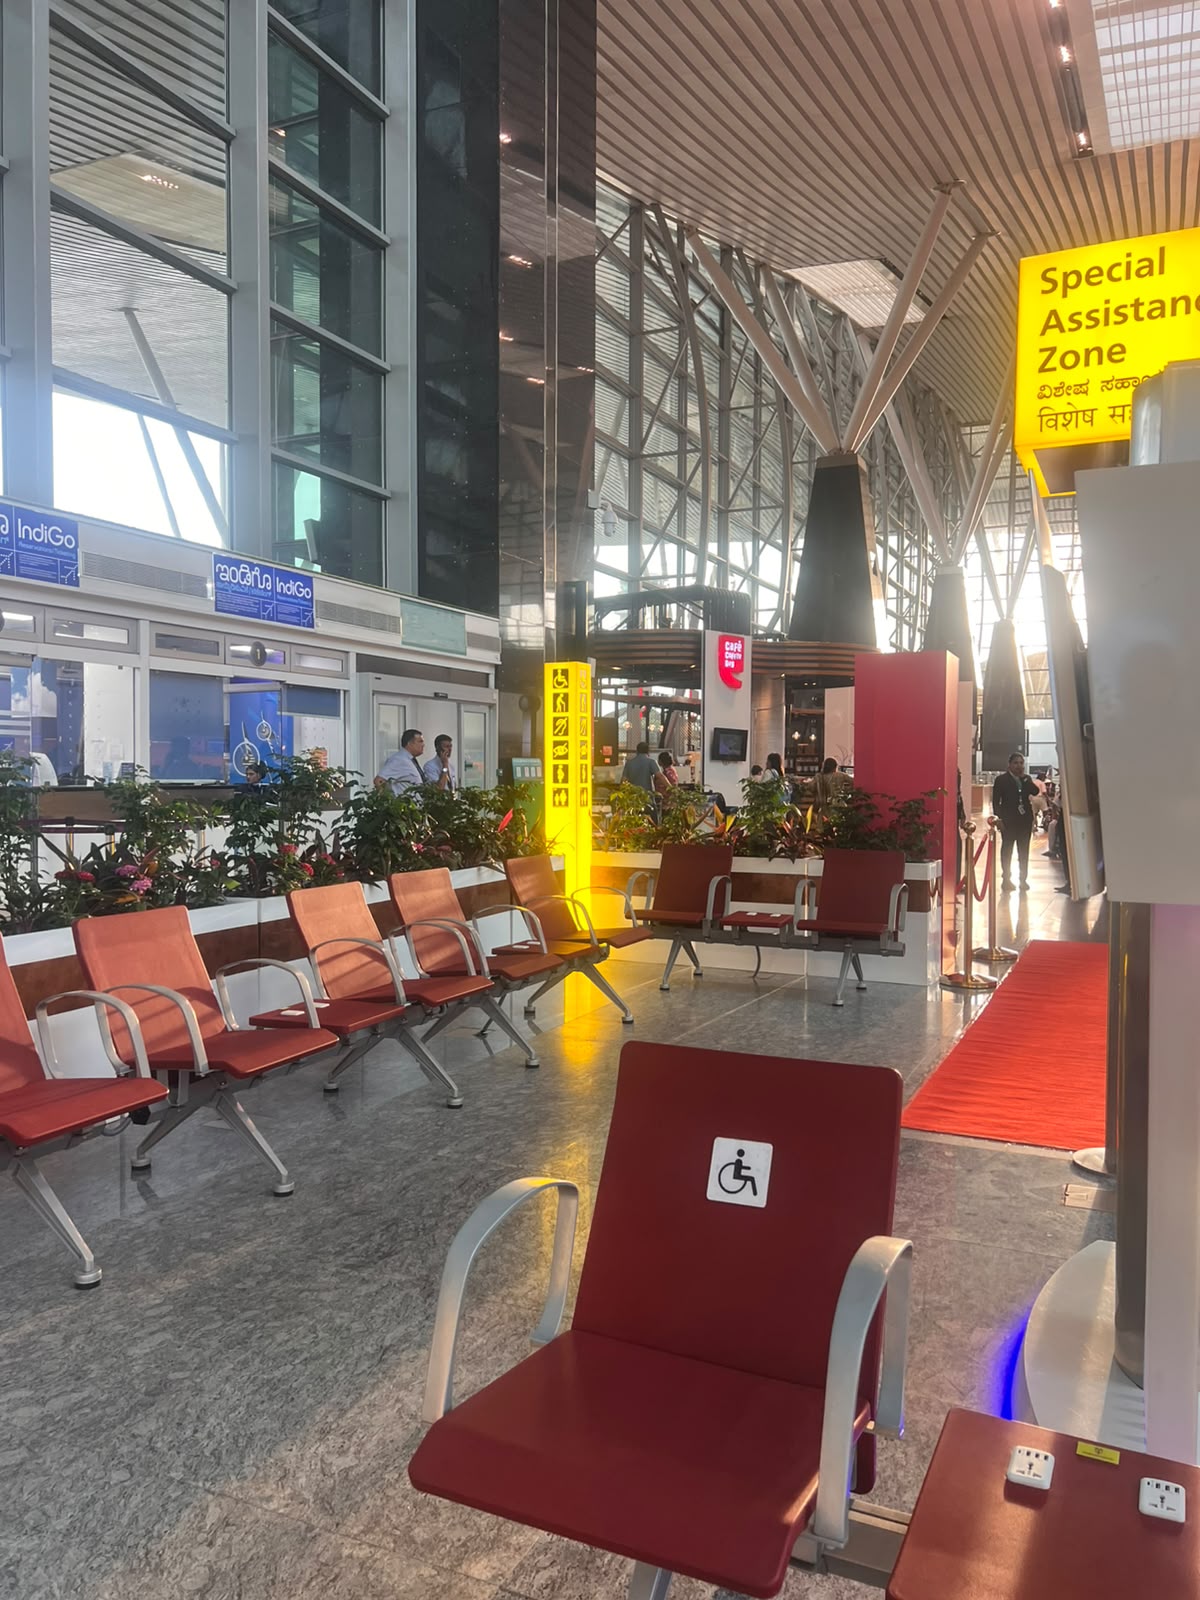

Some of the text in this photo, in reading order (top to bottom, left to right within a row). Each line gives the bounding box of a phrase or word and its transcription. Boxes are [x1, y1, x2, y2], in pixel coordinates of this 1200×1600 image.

[1040, 246, 1166, 298] Special
[1037, 342, 1127, 374] Zone
[1037, 378, 1090, 400] ವಿಶೇಷ
[1037, 402, 1098, 433] विशेष
[17, 518, 76, 549] IndiGo
[276, 576, 312, 599] IndiGo
